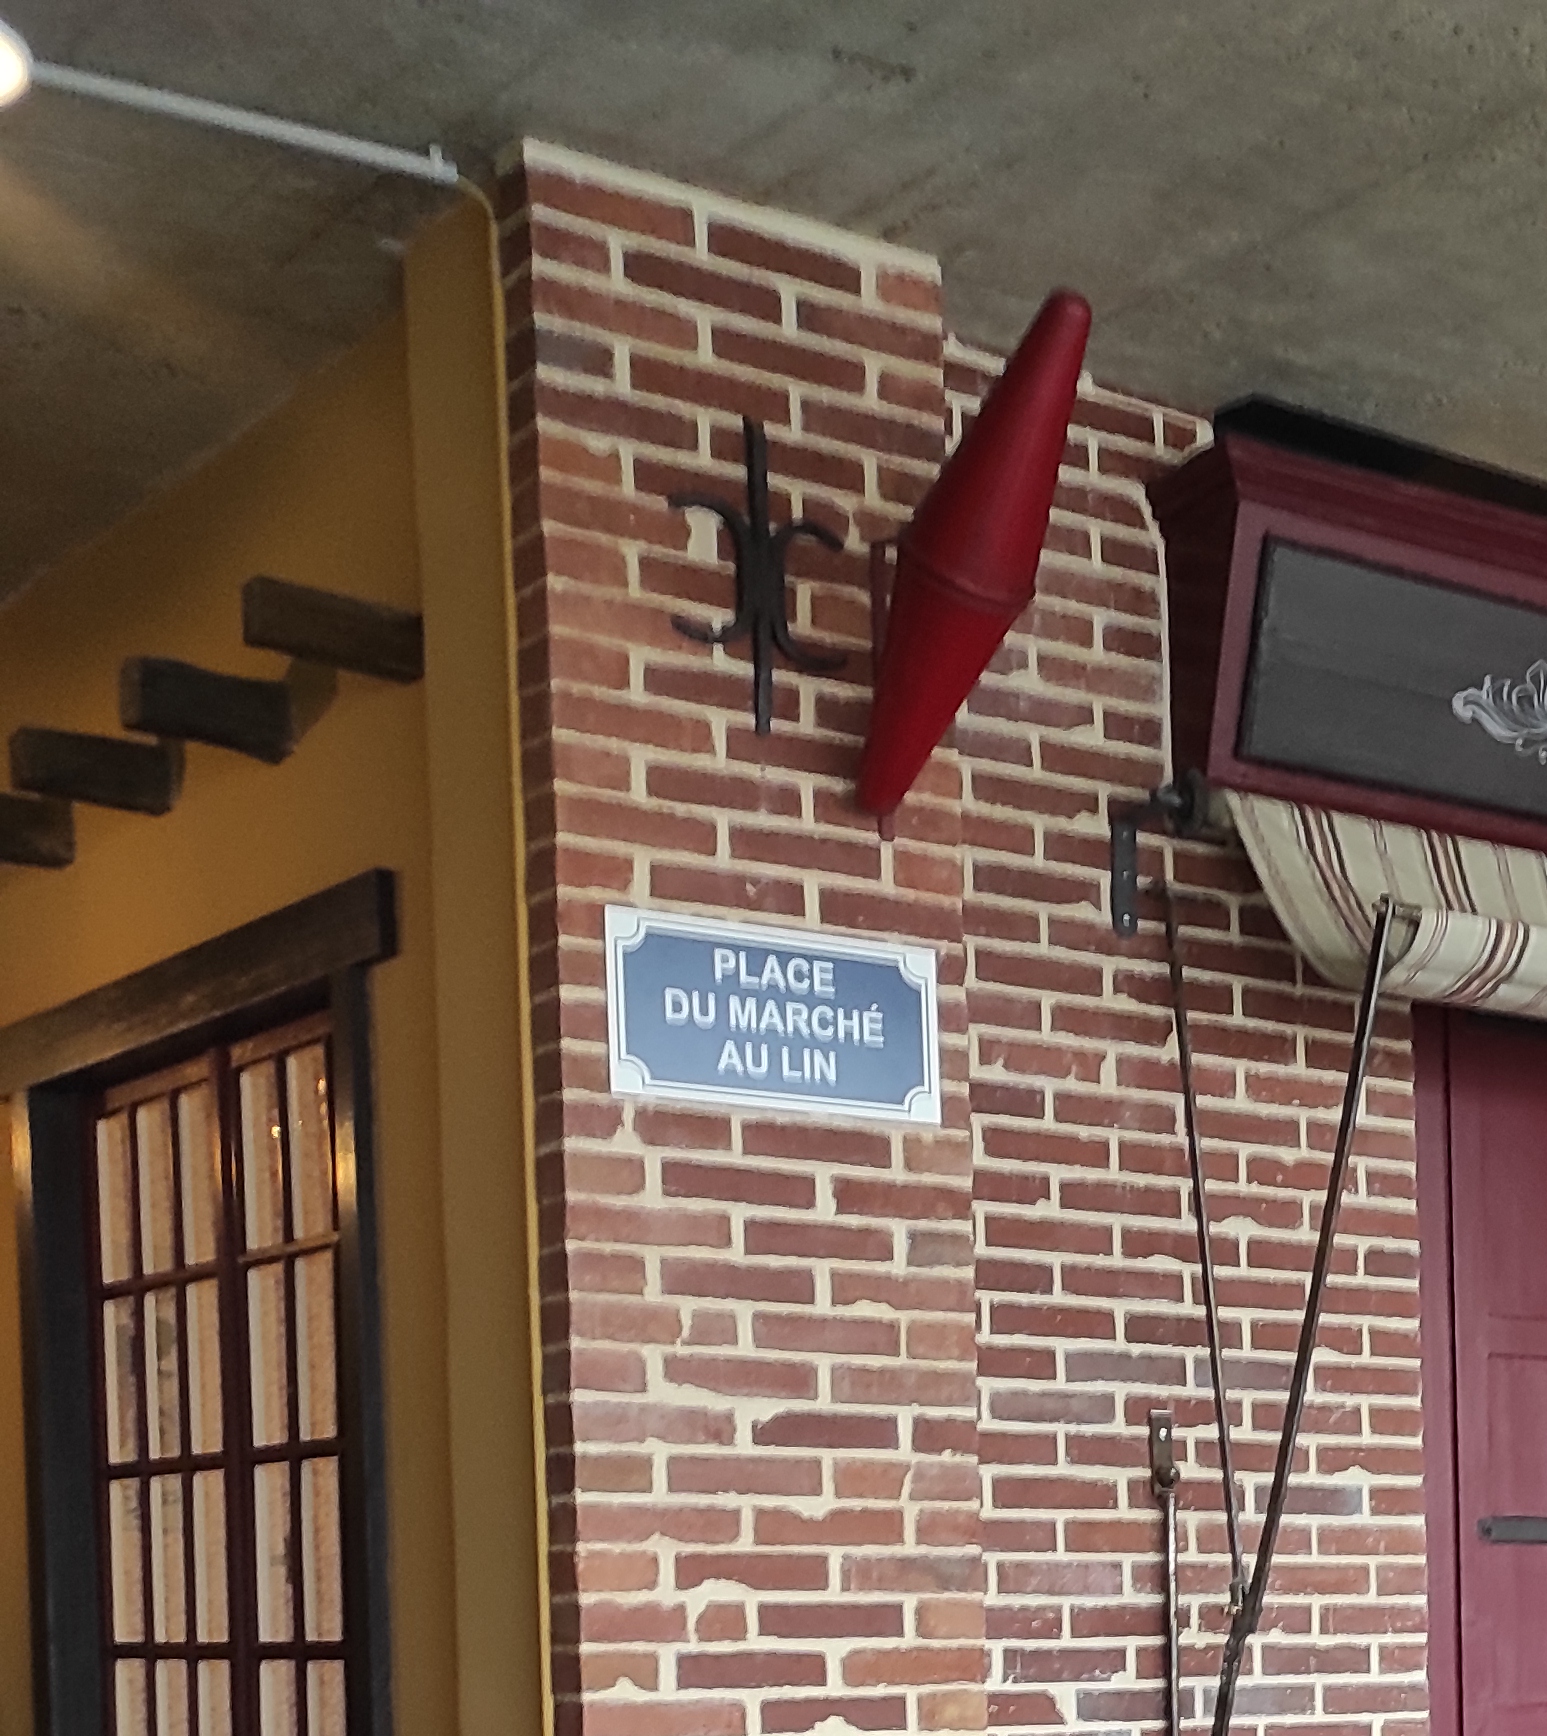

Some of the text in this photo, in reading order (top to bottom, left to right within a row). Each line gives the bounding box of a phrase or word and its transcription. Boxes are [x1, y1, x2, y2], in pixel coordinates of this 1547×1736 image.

[712, 947, 837, 999] PLACE
[663, 987, 886, 1049] DU MARCHÉ
[716, 1039, 838, 1087] AU LIN
